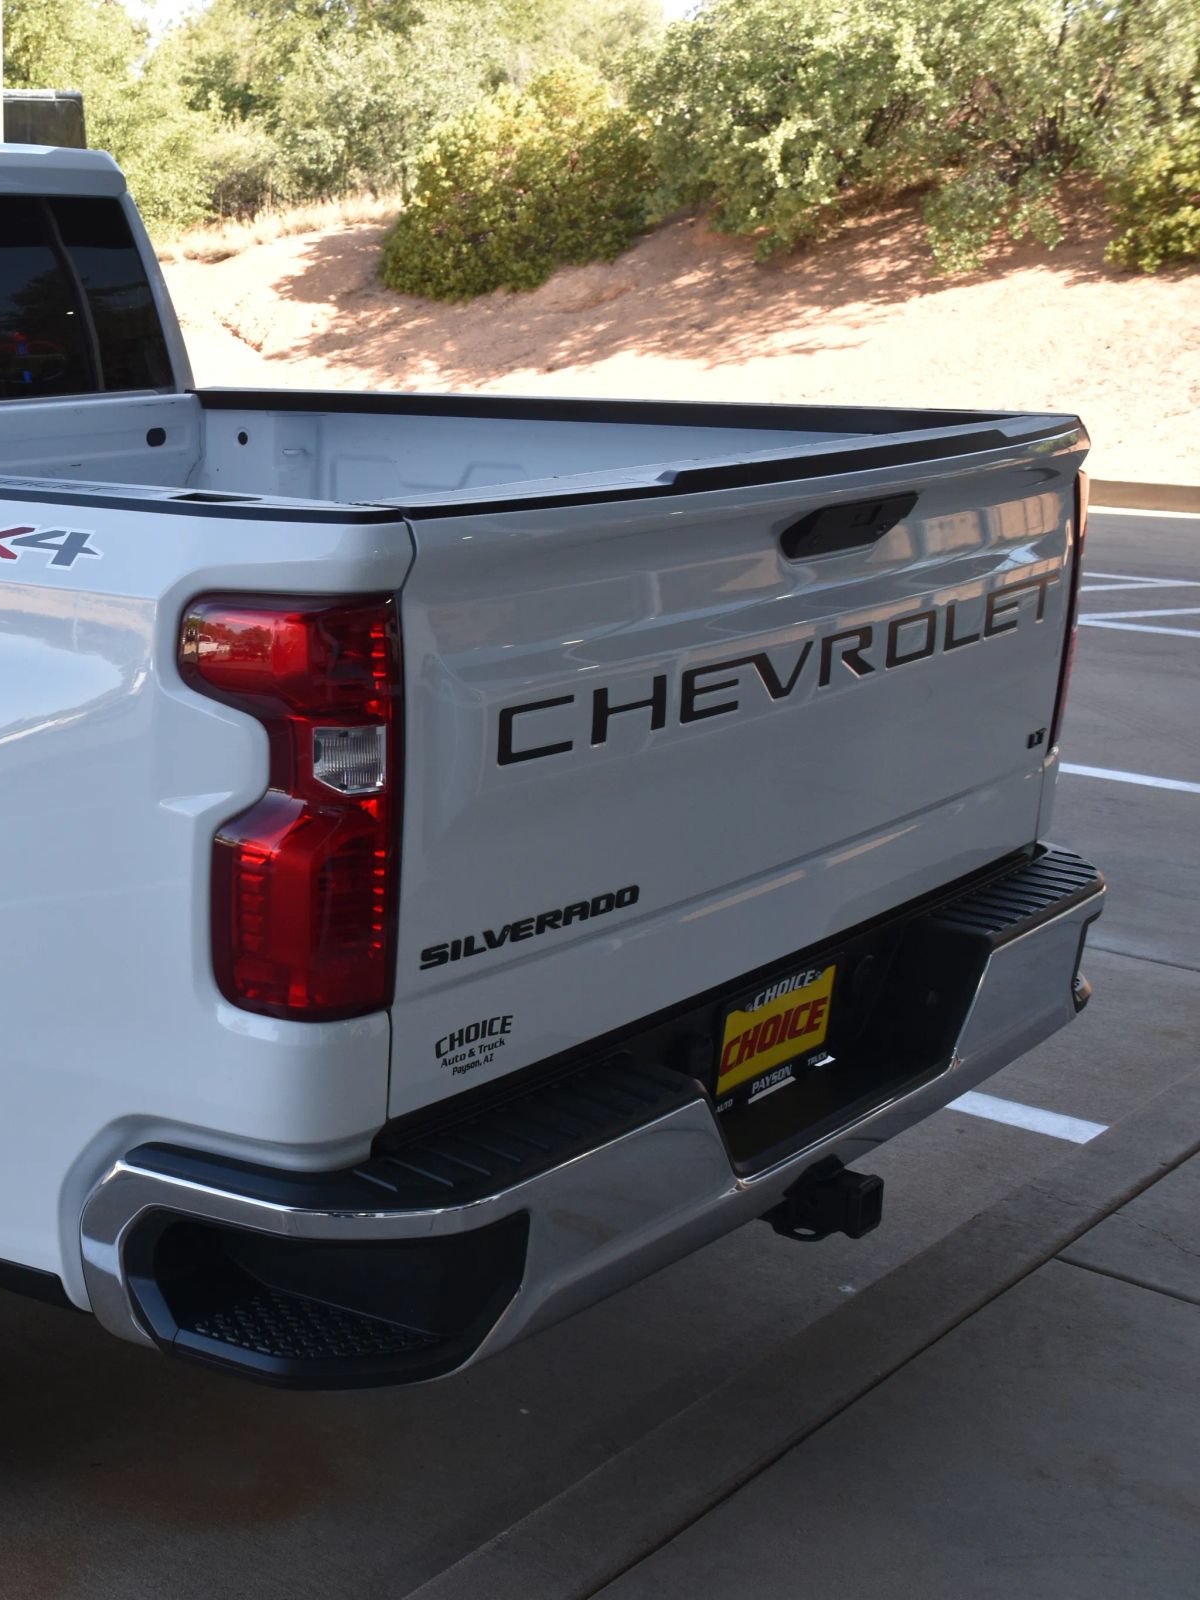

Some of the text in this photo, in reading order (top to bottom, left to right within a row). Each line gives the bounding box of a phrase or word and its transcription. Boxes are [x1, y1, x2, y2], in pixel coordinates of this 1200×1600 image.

[497, 573, 1060, 766] CHEVROLET
[1026, 727, 1047, 749] LT
[419, 884, 640, 970] SILVERADO
[752, 969, 817, 1012] CHOICE
[435, 1014, 514, 1059] CHOICE
[441, 1037, 506, 1068] Auto & Truck
[719, 996, 829, 1078] CHOICE
[751, 1064, 793, 1095] PAYSON
